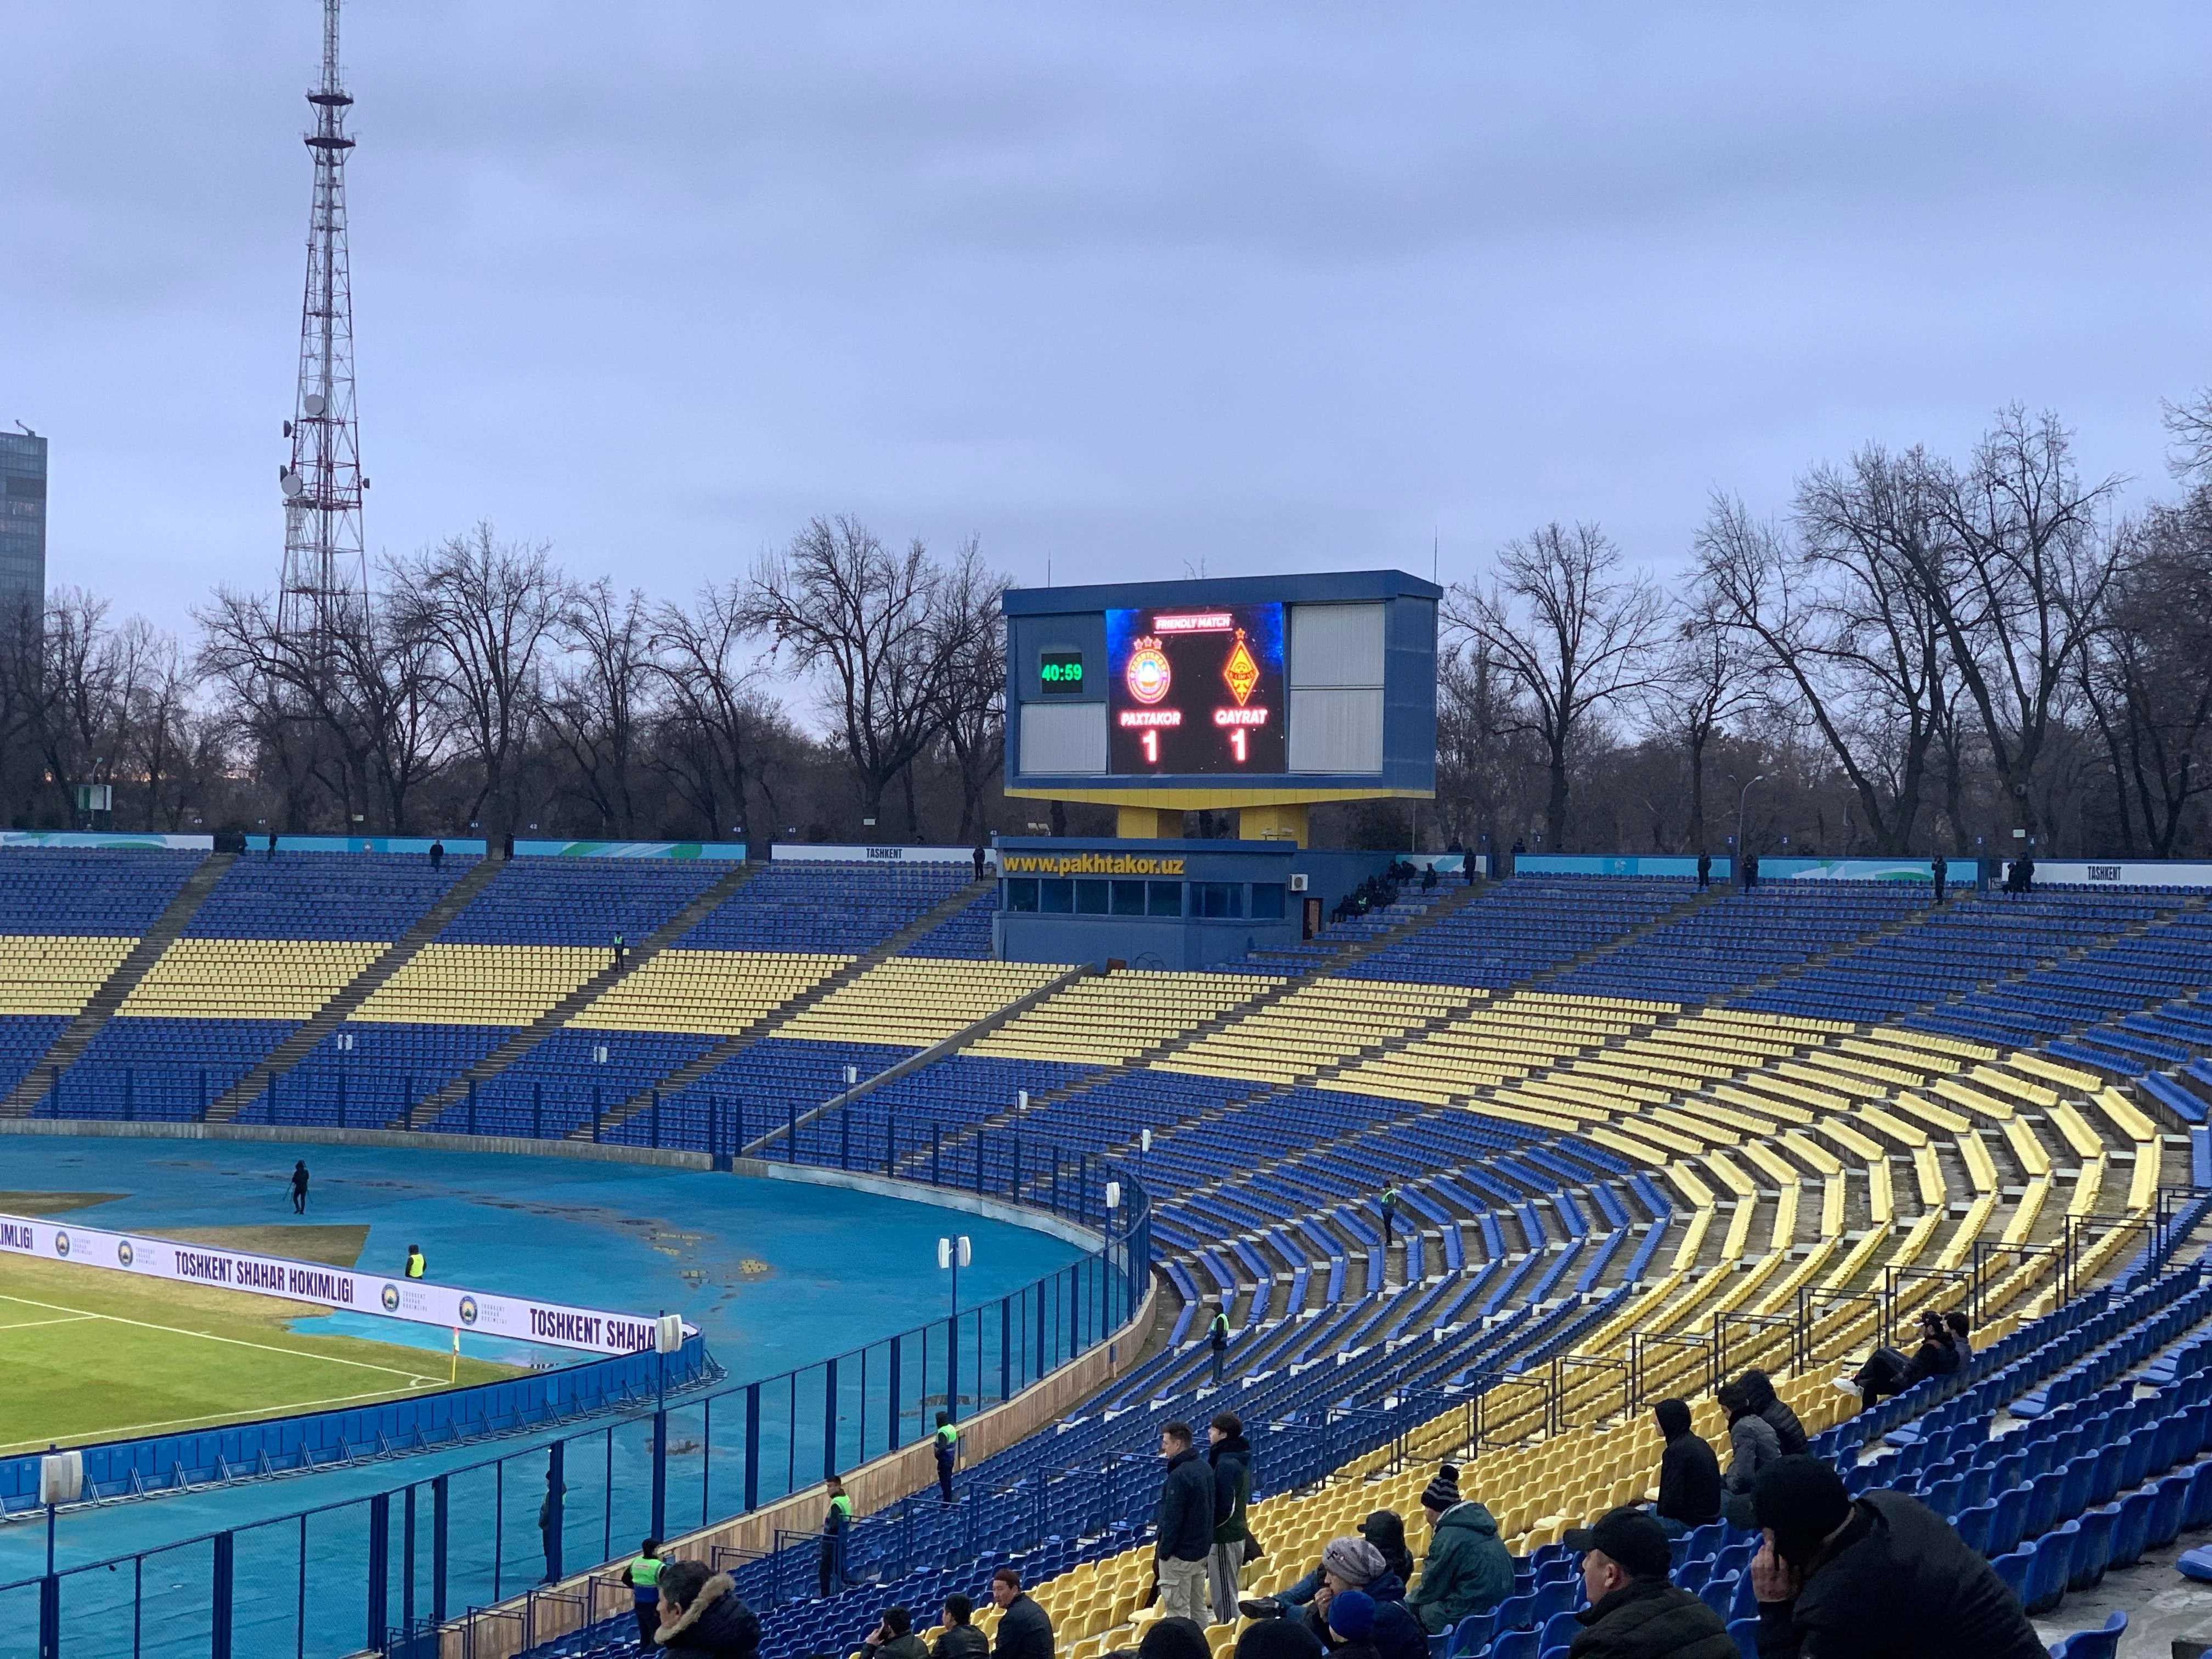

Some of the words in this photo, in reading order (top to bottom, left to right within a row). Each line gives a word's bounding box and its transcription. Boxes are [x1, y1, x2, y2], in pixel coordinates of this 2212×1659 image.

[1156, 618, 1197, 629] FRIENDLY
[1198, 616, 1230, 628] MATCH
[1042, 664, 1081, 681] 40:59
[1121, 712, 1181, 726] PAXTAKOR
[1216, 709, 1268, 724] QAYRAT
[1143, 730, 1156, 761] 1
[1231, 729, 1245, 760] 1
[867, 848, 902, 859] TASHKENT
[1003, 853, 1184, 877] www.pakhtakor.uz
[2087, 866, 2121, 881] TASHKENT
[0, 1223, 33, 1250] IMLIGI
[175, 1251, 233, 1283] TOSHKENT
[236, 1261, 285, 1291] SHAHAR
[290, 1268, 354, 1304] HOKIMLIGI
[530, 1308, 601, 1345] TOSHKENT
[607, 1321, 656, 1350] SHAHA
